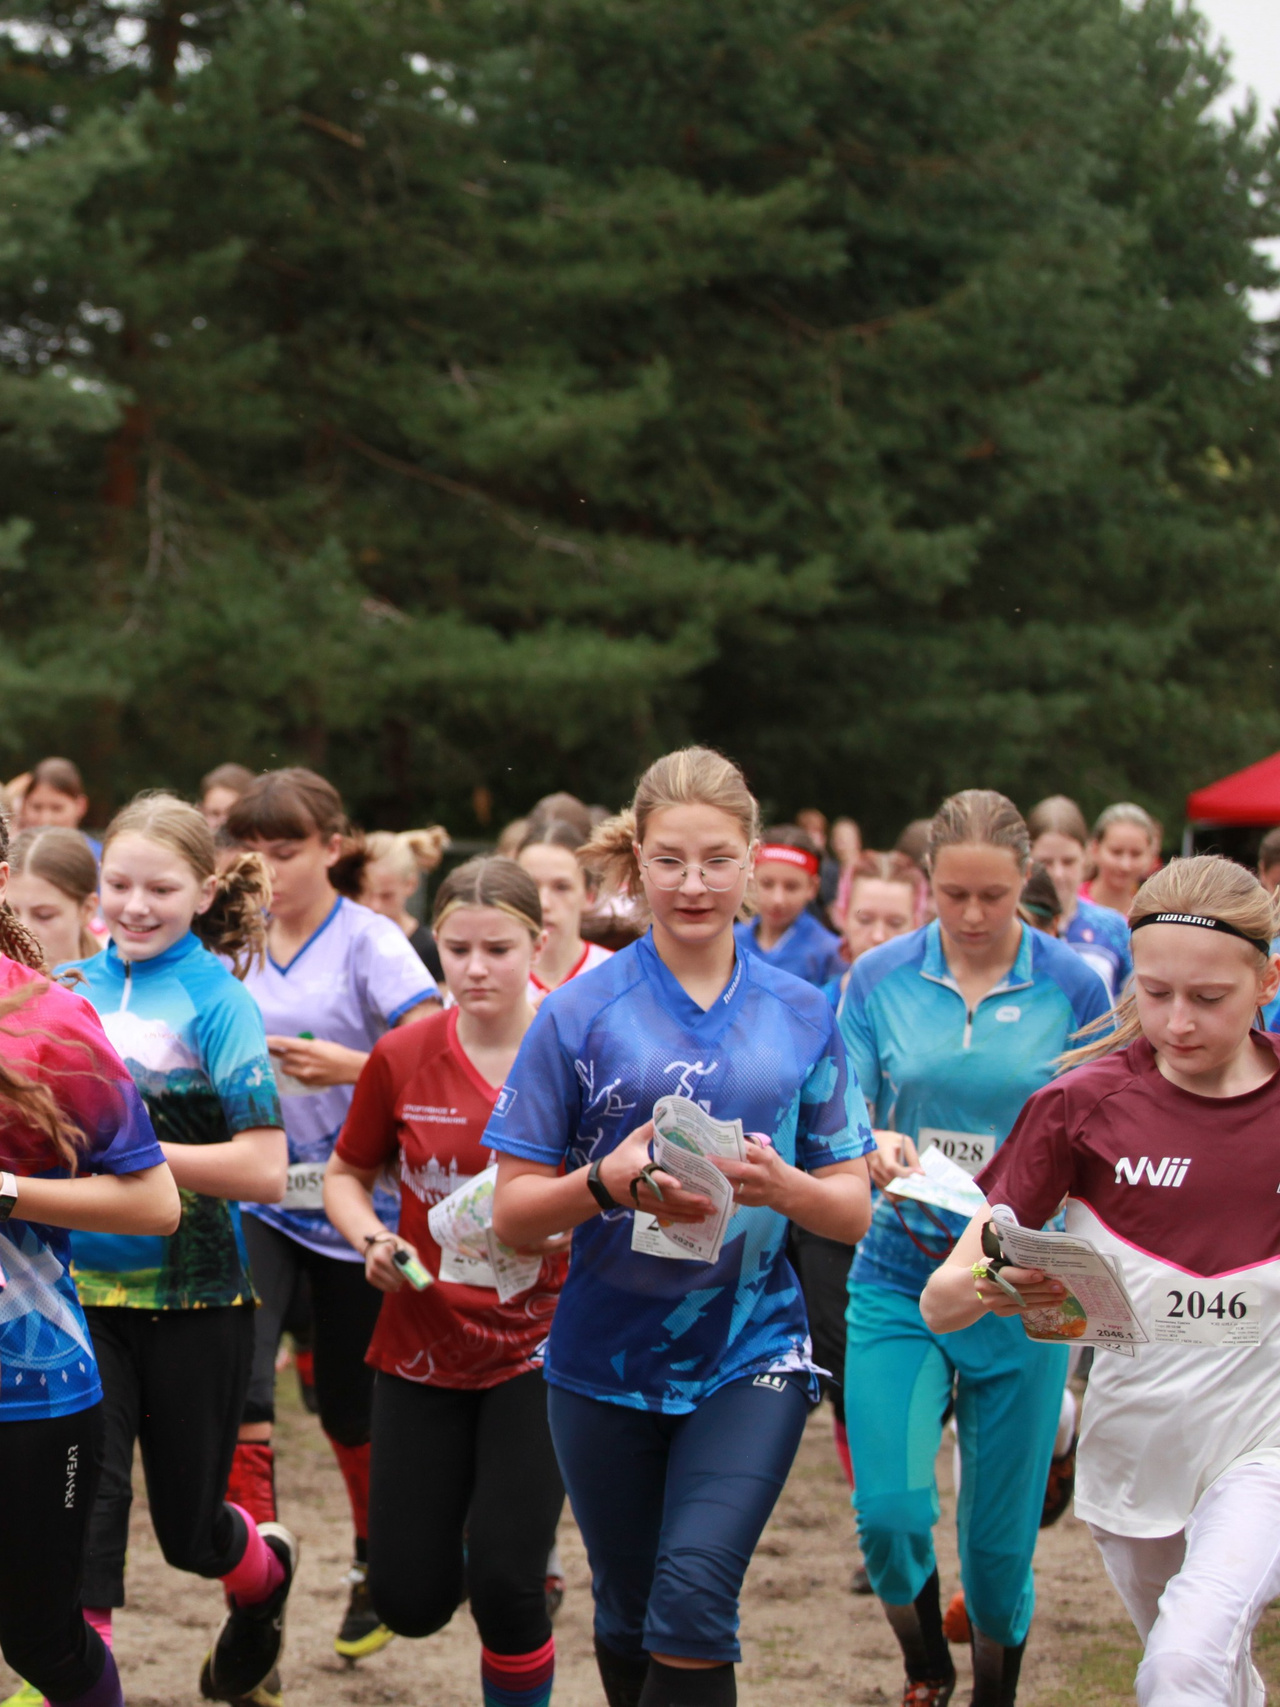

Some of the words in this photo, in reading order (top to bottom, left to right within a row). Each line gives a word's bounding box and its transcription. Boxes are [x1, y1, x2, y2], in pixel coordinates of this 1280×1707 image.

[1156, 913, 1216, 927] noname
[1166, 1290, 1247, 1319] 2046
[1097, 1329, 1134, 1340] 2046.1
